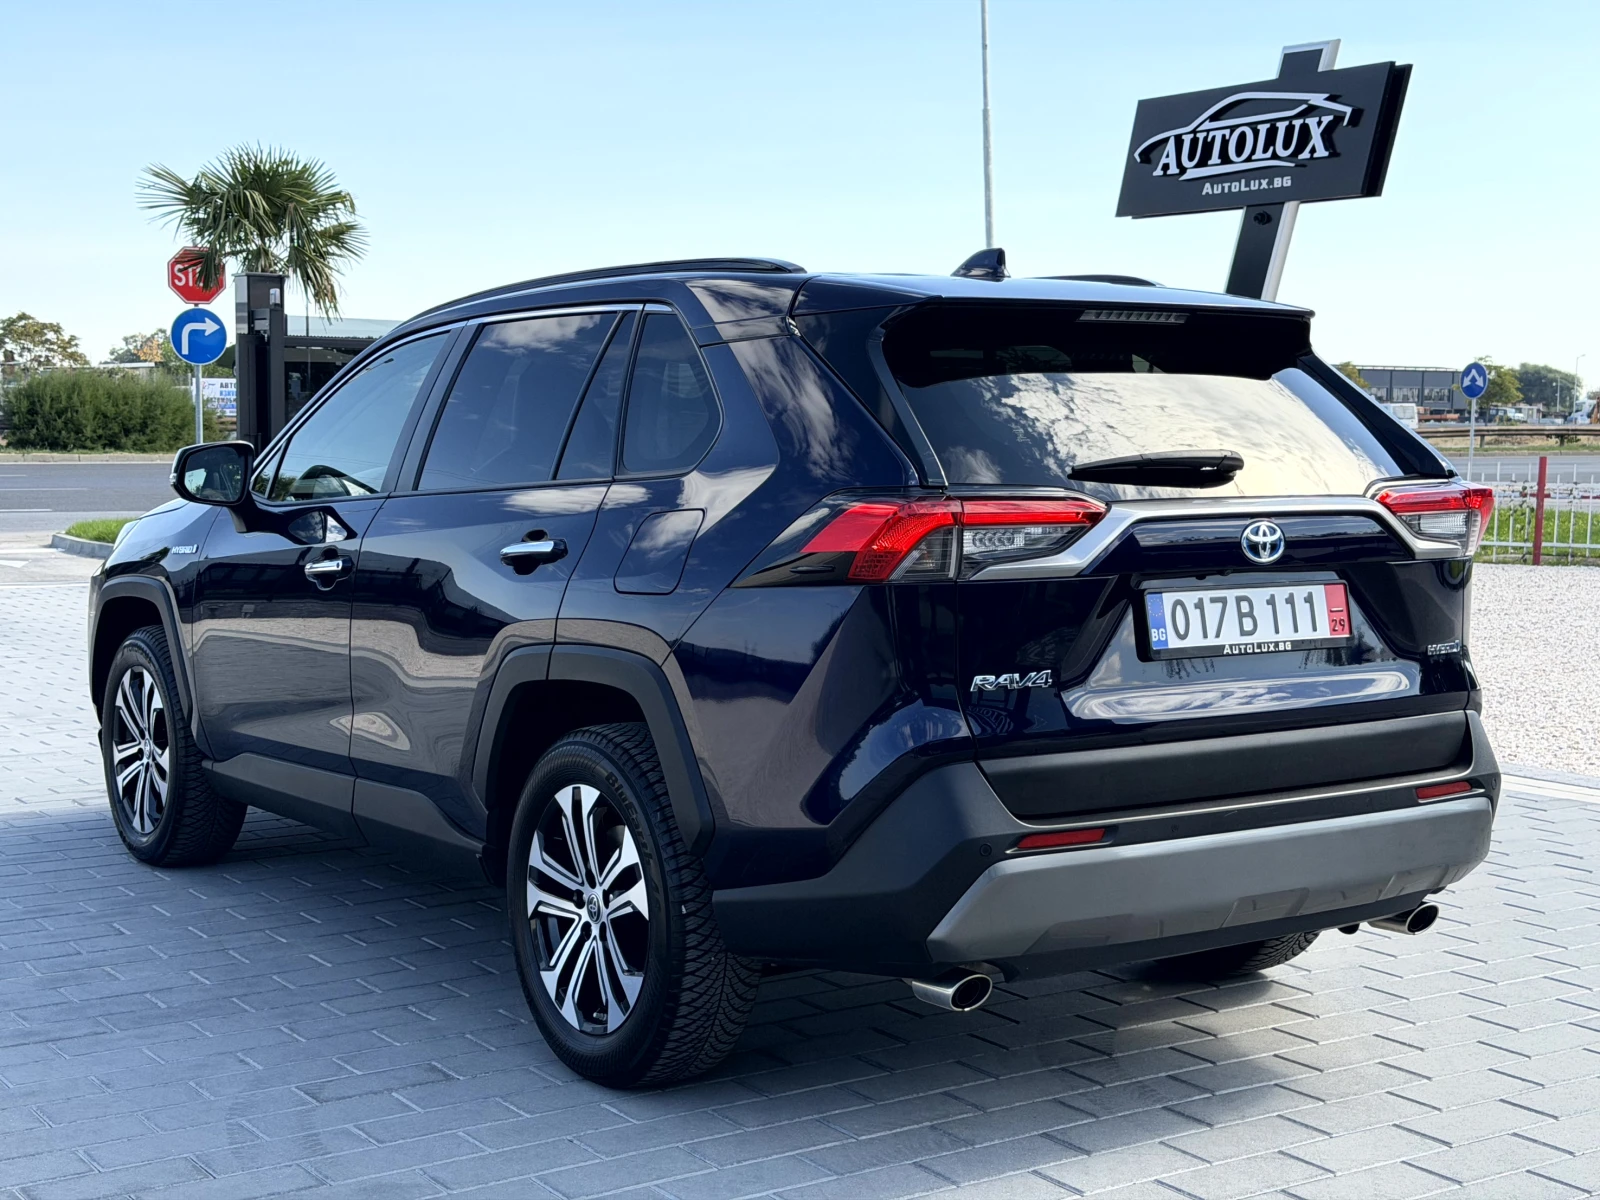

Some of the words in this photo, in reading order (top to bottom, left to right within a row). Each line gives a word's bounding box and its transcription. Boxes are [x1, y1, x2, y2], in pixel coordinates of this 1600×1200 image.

[1153, 115, 1334, 176] AUTOLUX
[1151, 628, 1166, 642] BG
[1331, 618, 1346, 632] 29
[970, 670, 1052, 692] RAV4
